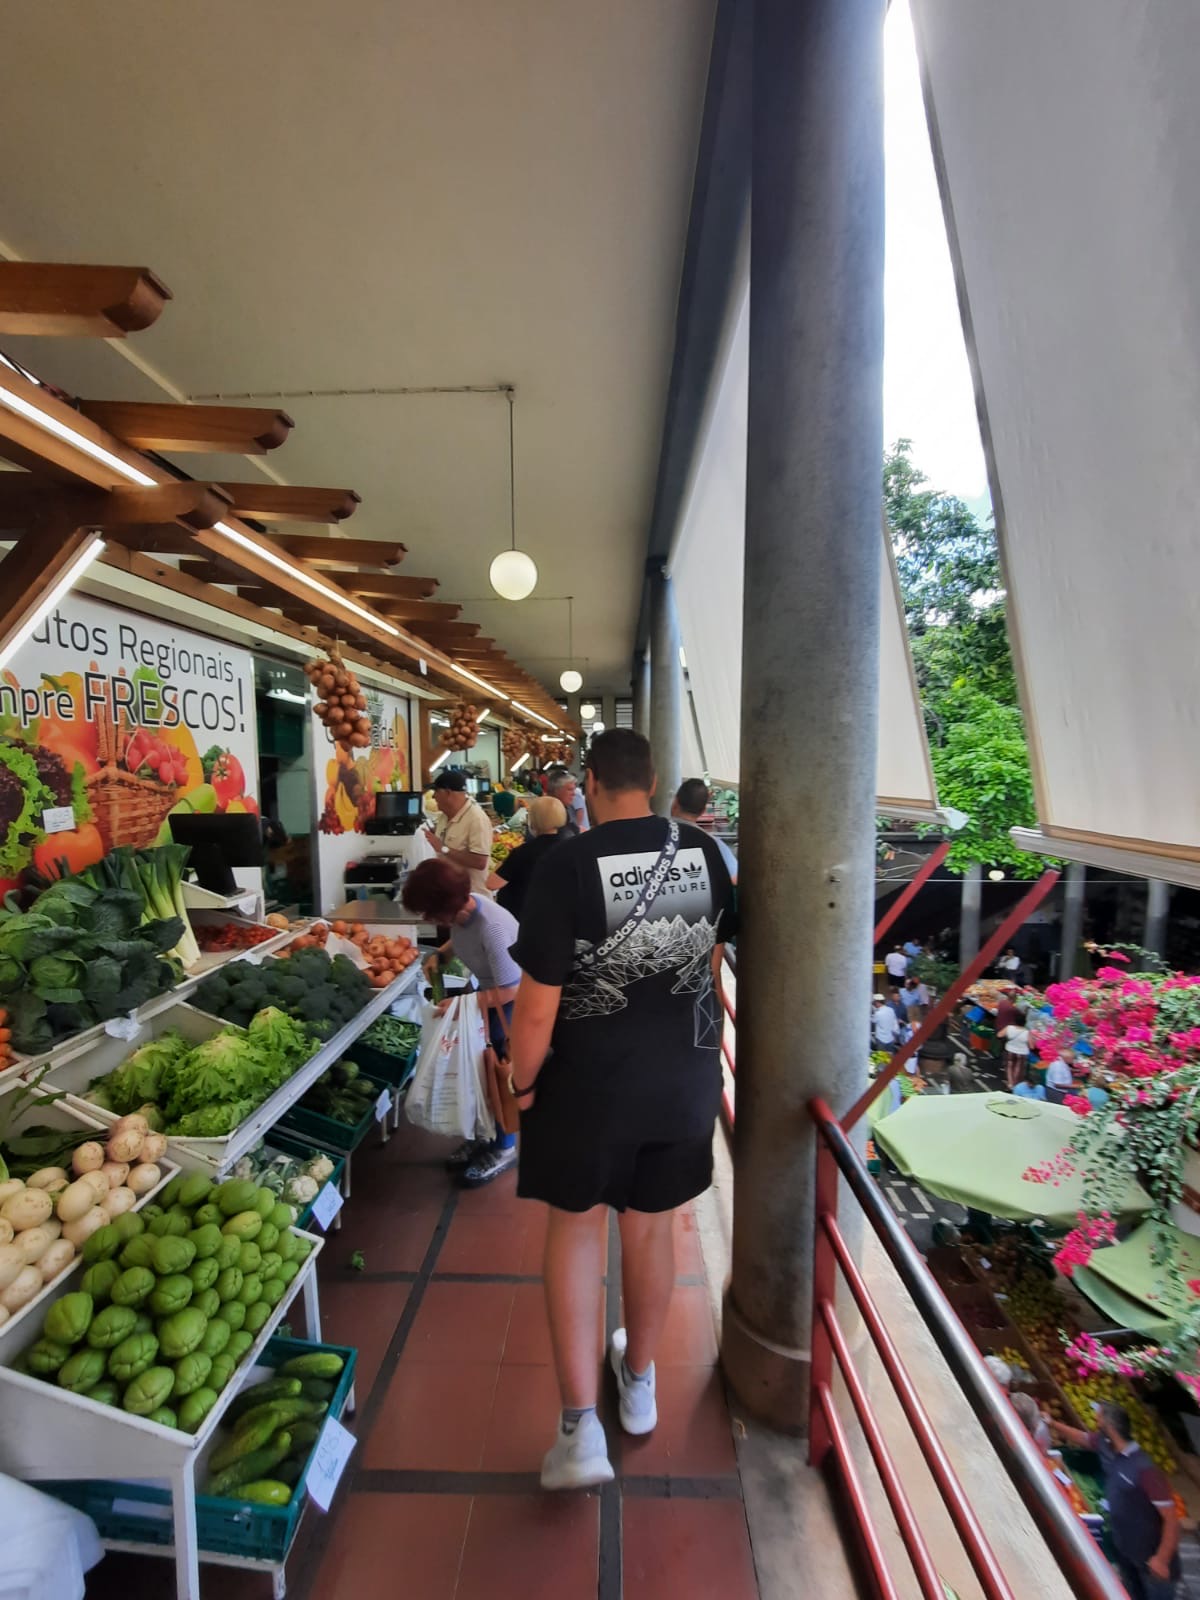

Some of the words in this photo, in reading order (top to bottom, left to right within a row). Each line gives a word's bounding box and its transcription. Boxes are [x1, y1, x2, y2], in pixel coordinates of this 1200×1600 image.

[119, 624, 233, 682] Regionais
[84, 671, 245, 733] FRESCOS!
[610, 866, 681, 887] adids
[613, 881, 707, 902] ADVNTURE
[646, 858, 672, 900] adidas
[597, 919, 637, 956] adidas
